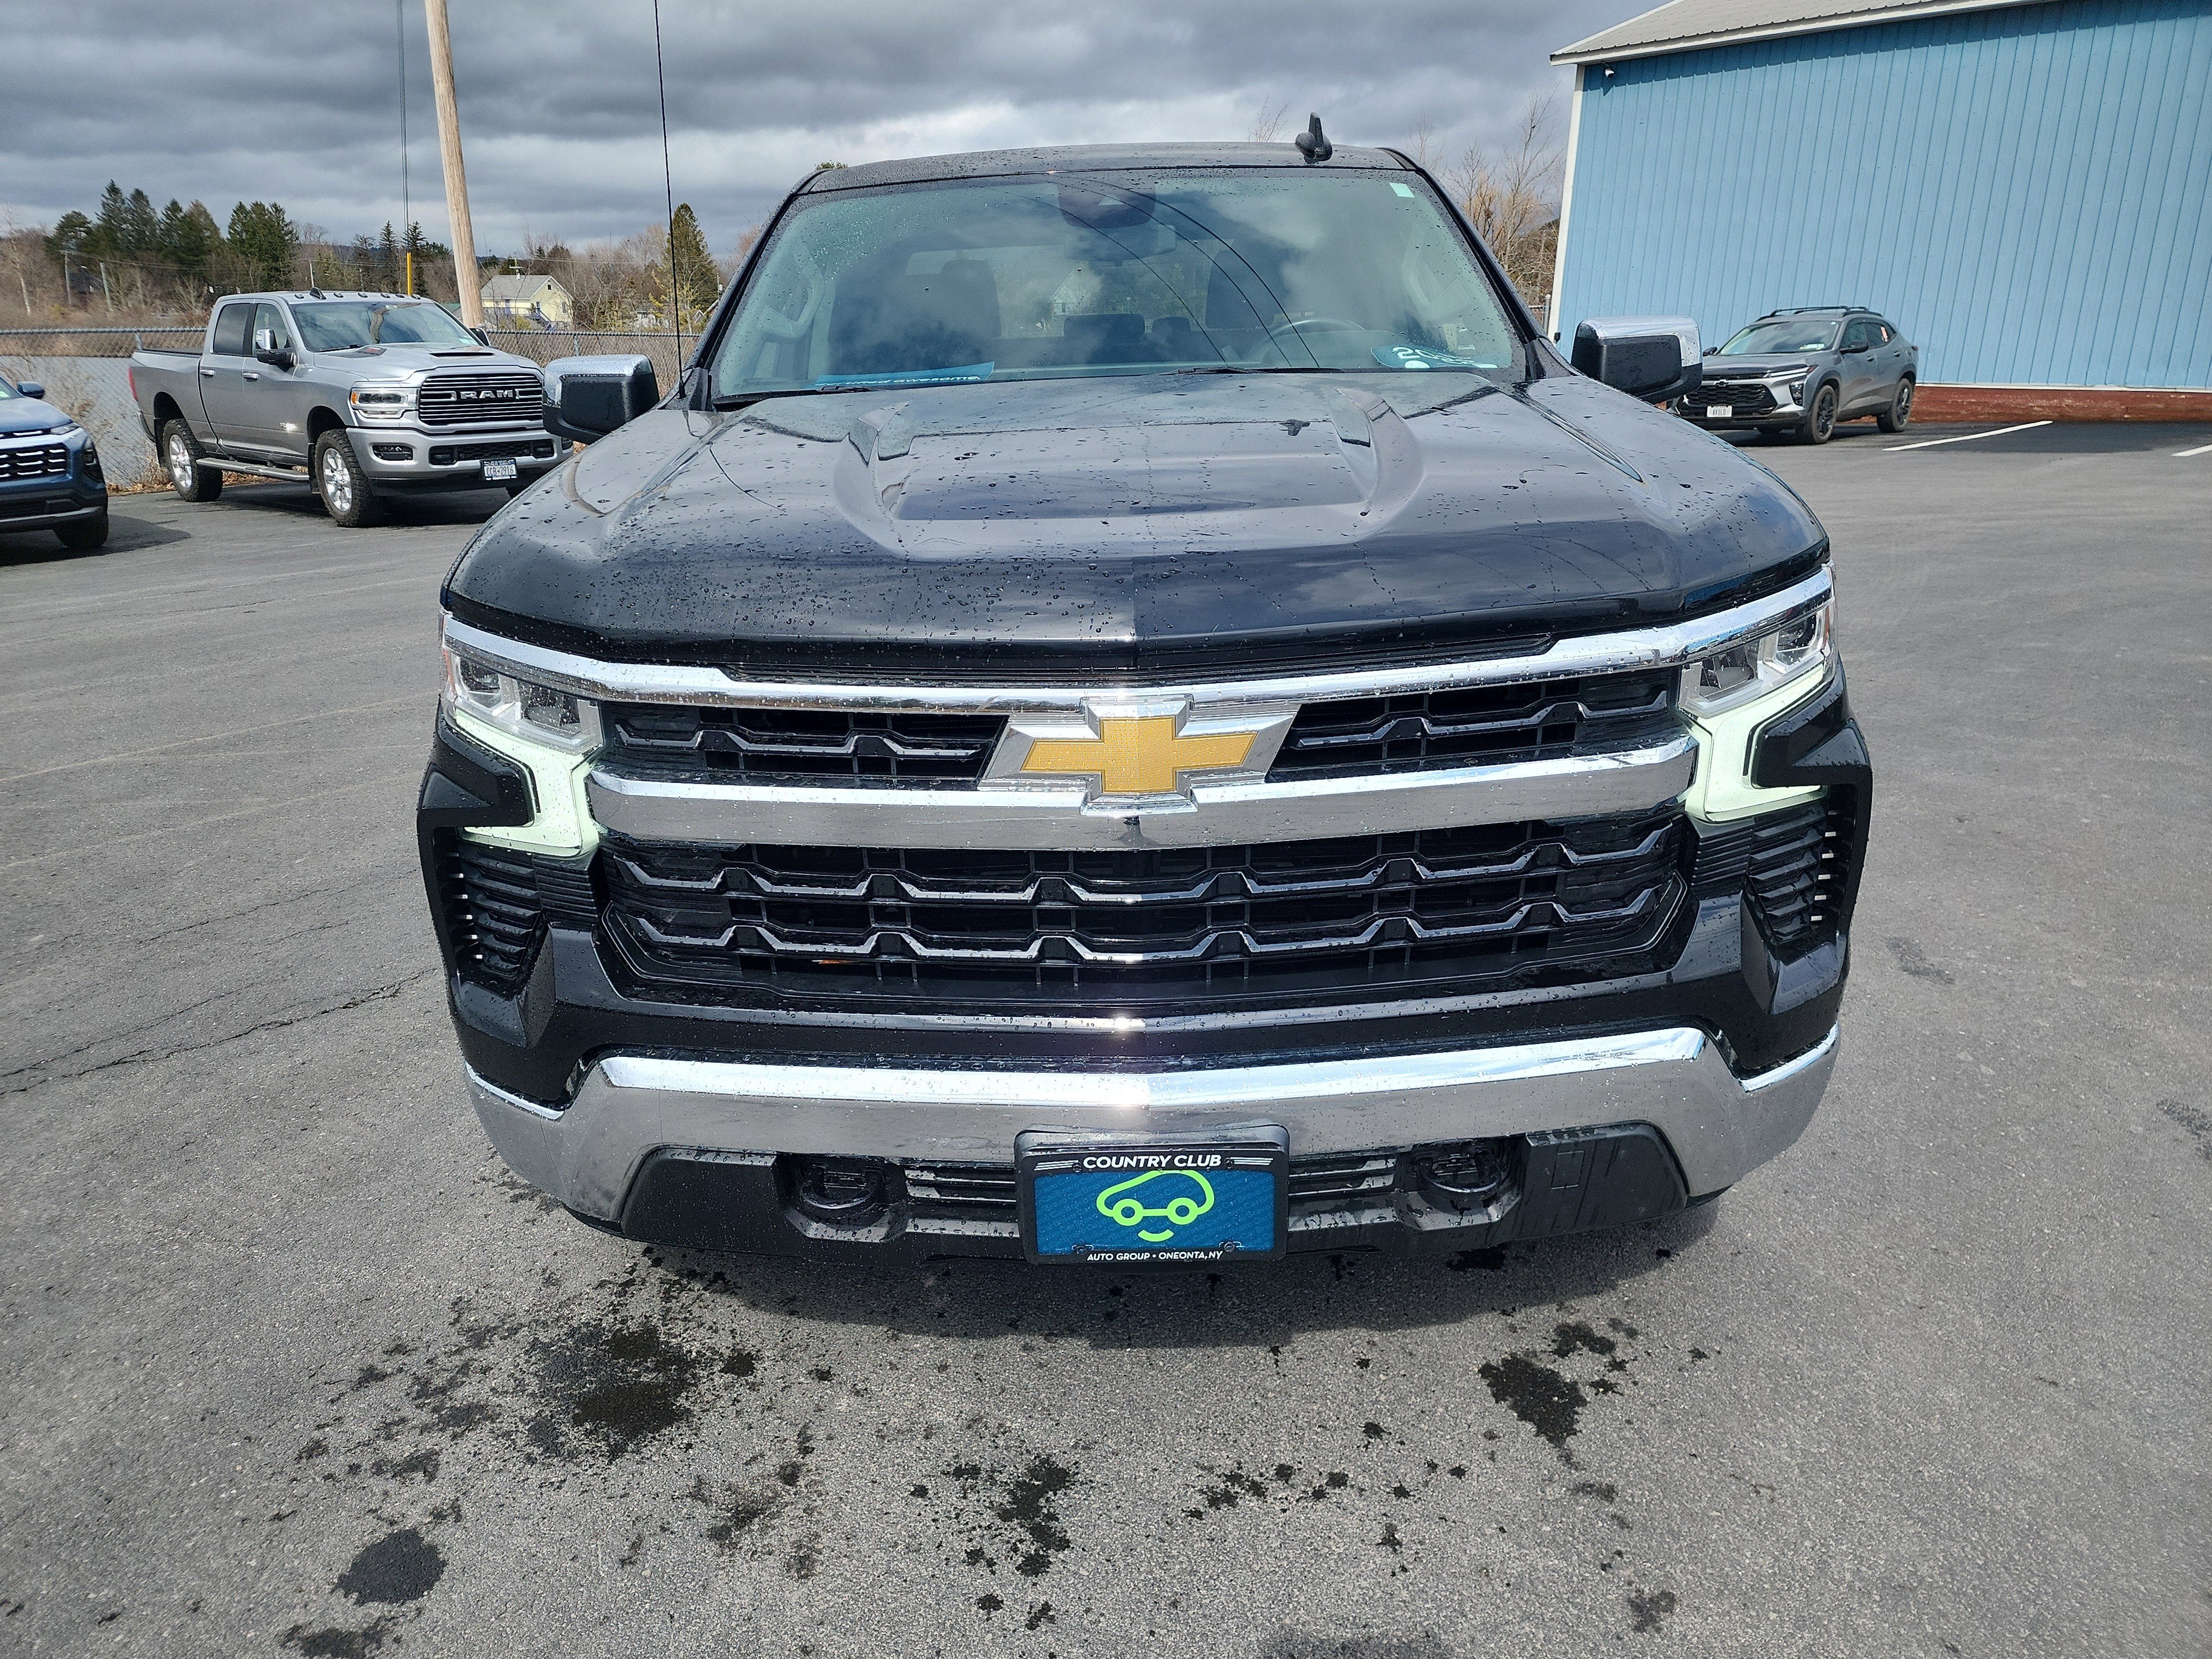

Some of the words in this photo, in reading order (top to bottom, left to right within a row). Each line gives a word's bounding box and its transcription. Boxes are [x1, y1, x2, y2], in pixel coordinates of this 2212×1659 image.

[460, 390, 513, 399] RAM
[1083, 1155, 1172, 1168] COUNTRY
[1173, 1155, 1222, 1167] CLUB
[1116, 1253, 1150, 1261] GROUP
